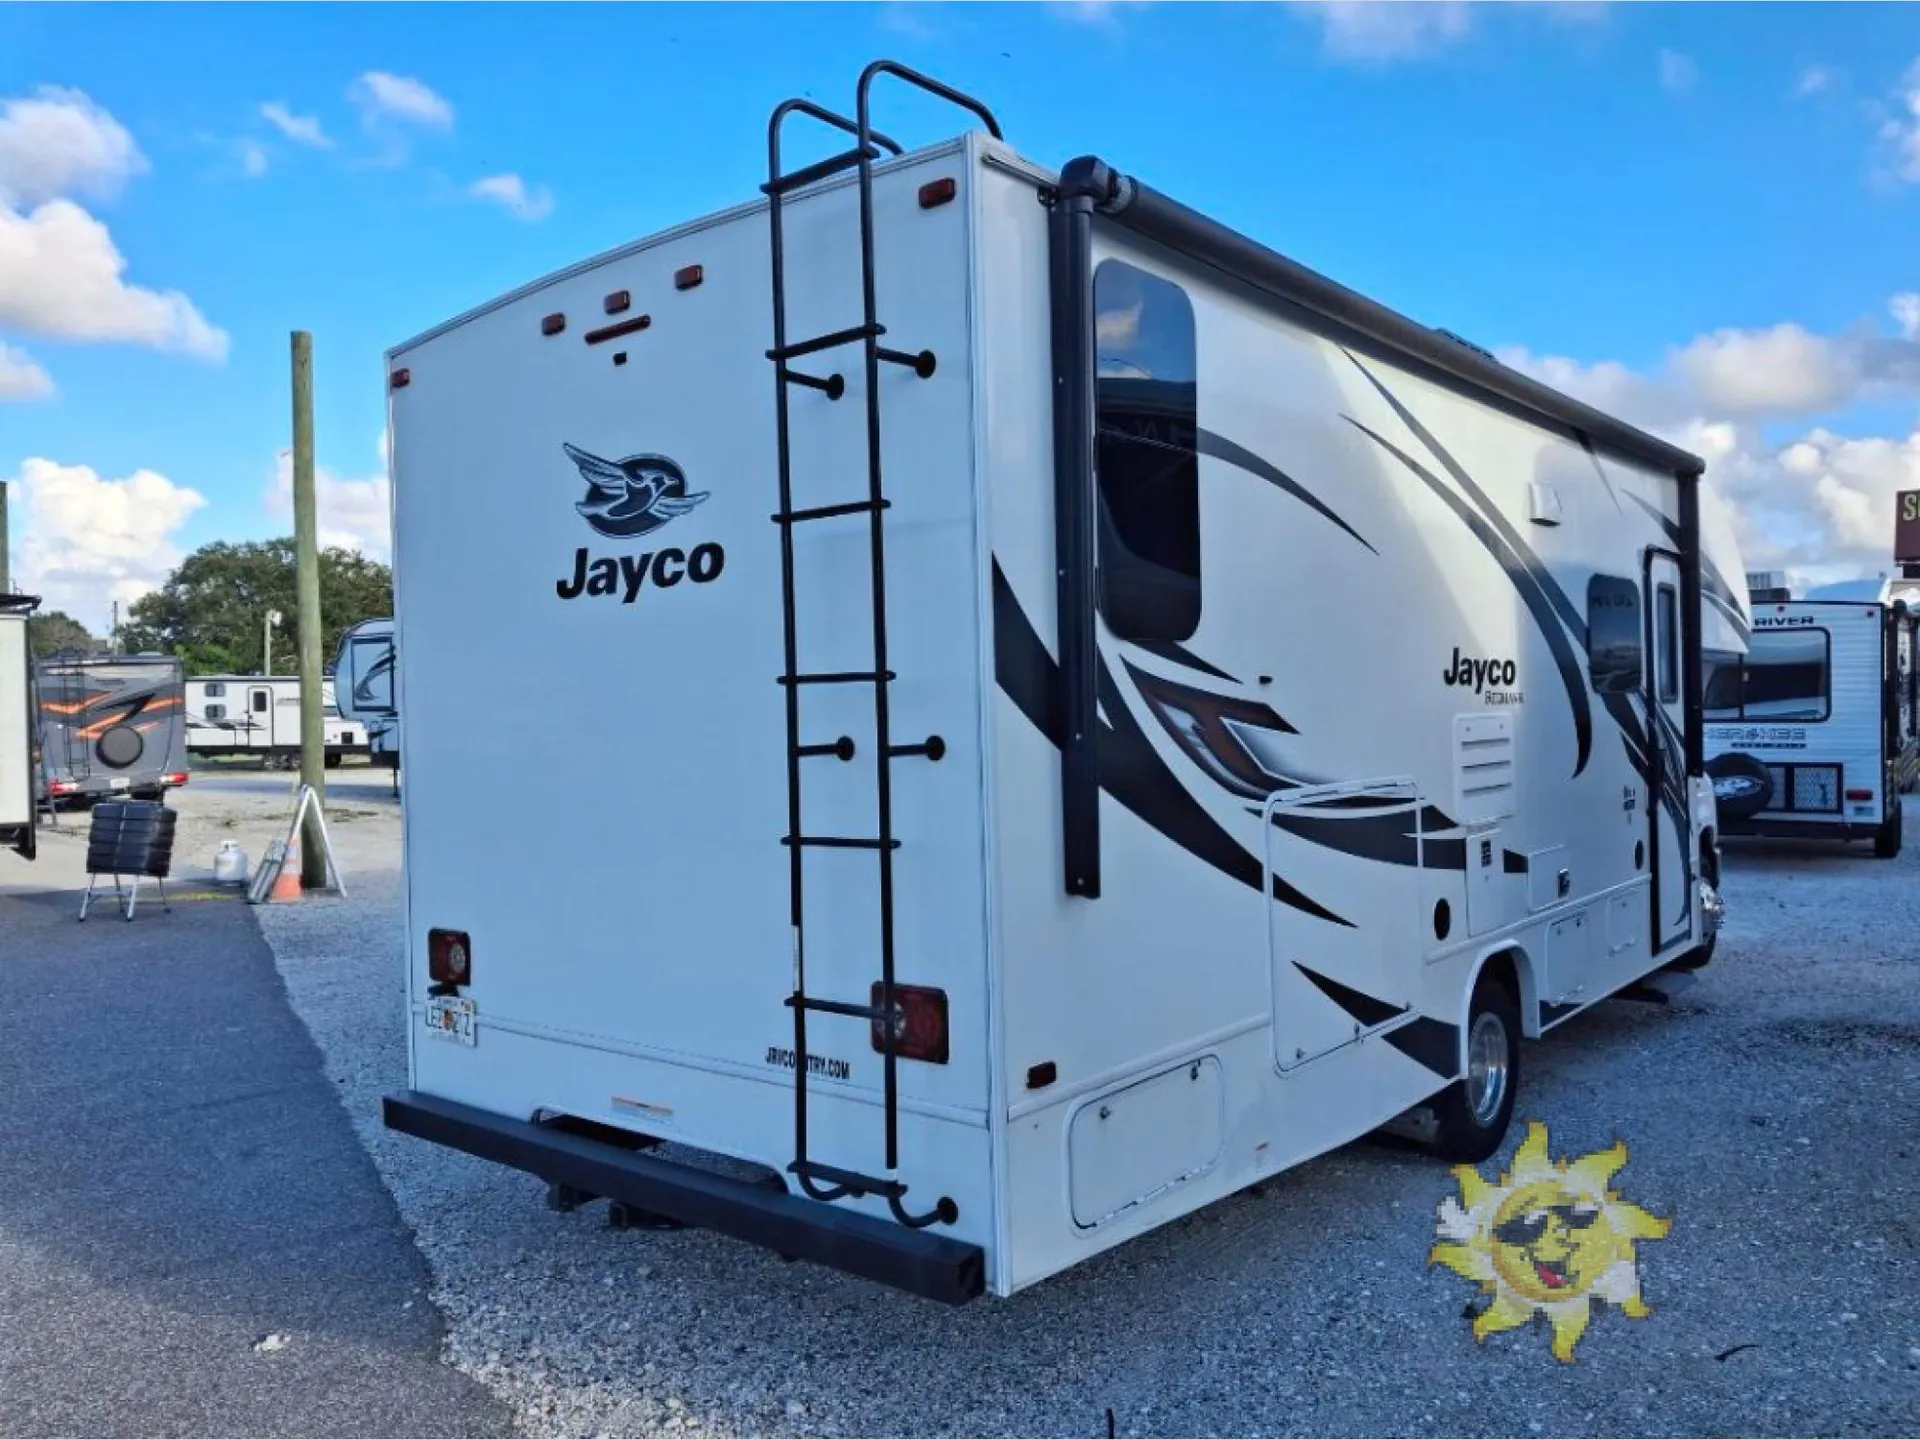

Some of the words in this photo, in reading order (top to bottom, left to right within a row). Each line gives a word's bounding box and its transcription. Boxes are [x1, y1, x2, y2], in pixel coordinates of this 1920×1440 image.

[556, 542, 724, 604] Jayco
[1755, 616, 1814, 626] RIVER
[1443, 646, 1516, 695] Jayco
